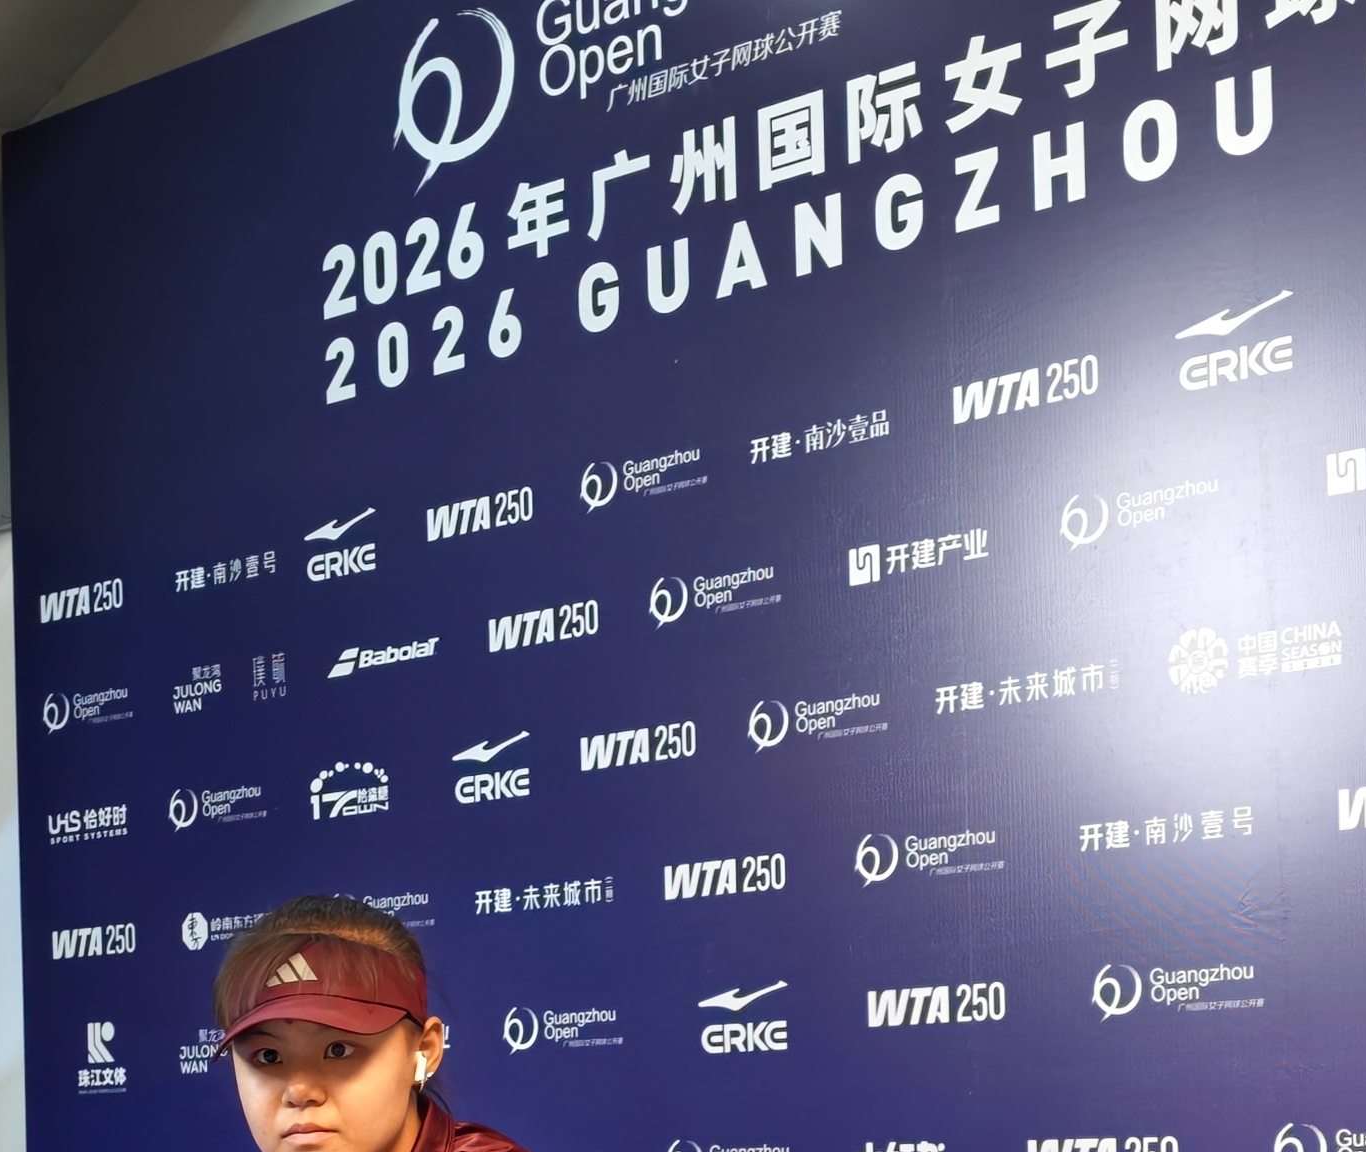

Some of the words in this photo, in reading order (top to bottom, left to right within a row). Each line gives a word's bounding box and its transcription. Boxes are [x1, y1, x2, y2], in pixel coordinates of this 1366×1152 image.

[539, 24, 662, 99] Open
[606, 9, 842, 112] 广州国际女子网球公开赛
[325, 287, 522, 405] 2026
[578, 34, 1274, 333] GUANGZHOU
[1178, 335, 1294, 392] ERKE
[952, 367, 1040, 425] WTA
[1046, 354, 1099, 404] 250
[623, 447, 700, 476] Guangzhou
[623, 470, 660, 492] Open
[426, 495, 491, 542] WTA
[494, 486, 533, 528] 250
[306, 542, 376, 582] ERKE
[885, 527, 990, 575] 开建产业
[40, 585, 91, 624] WTA
[93, 577, 123, 613] 250
[488, 607, 555, 653] WTA
[558, 599, 599, 640] 250
[1279, 620, 1342, 646] CHINA
[1281, 639, 1342, 662] SEASON
[172, 678, 222, 700] JULONG
[173, 697, 202, 715] WAN
[580, 727, 650, 772] WTA
[654, 720, 696, 761] 250
[454, 767, 530, 804] ERKE
[50, 833, 81, 845] SPORT
[83, 827, 128, 841] SYSTEMS
[51, 926, 103, 960] WTA
[105, 922, 136, 955] 250
[1150, 963, 1254, 988] Guangzhou
[1151, 983, 1200, 1006] Open
[543, 1008, 616, 1028] Guangzhou
[544, 1023, 579, 1044] Open
[700, 1020, 788, 1054] ERKE
[77, 1066, 127, 1088] 珠江文体
[180, 1059, 208, 1074] WAN
